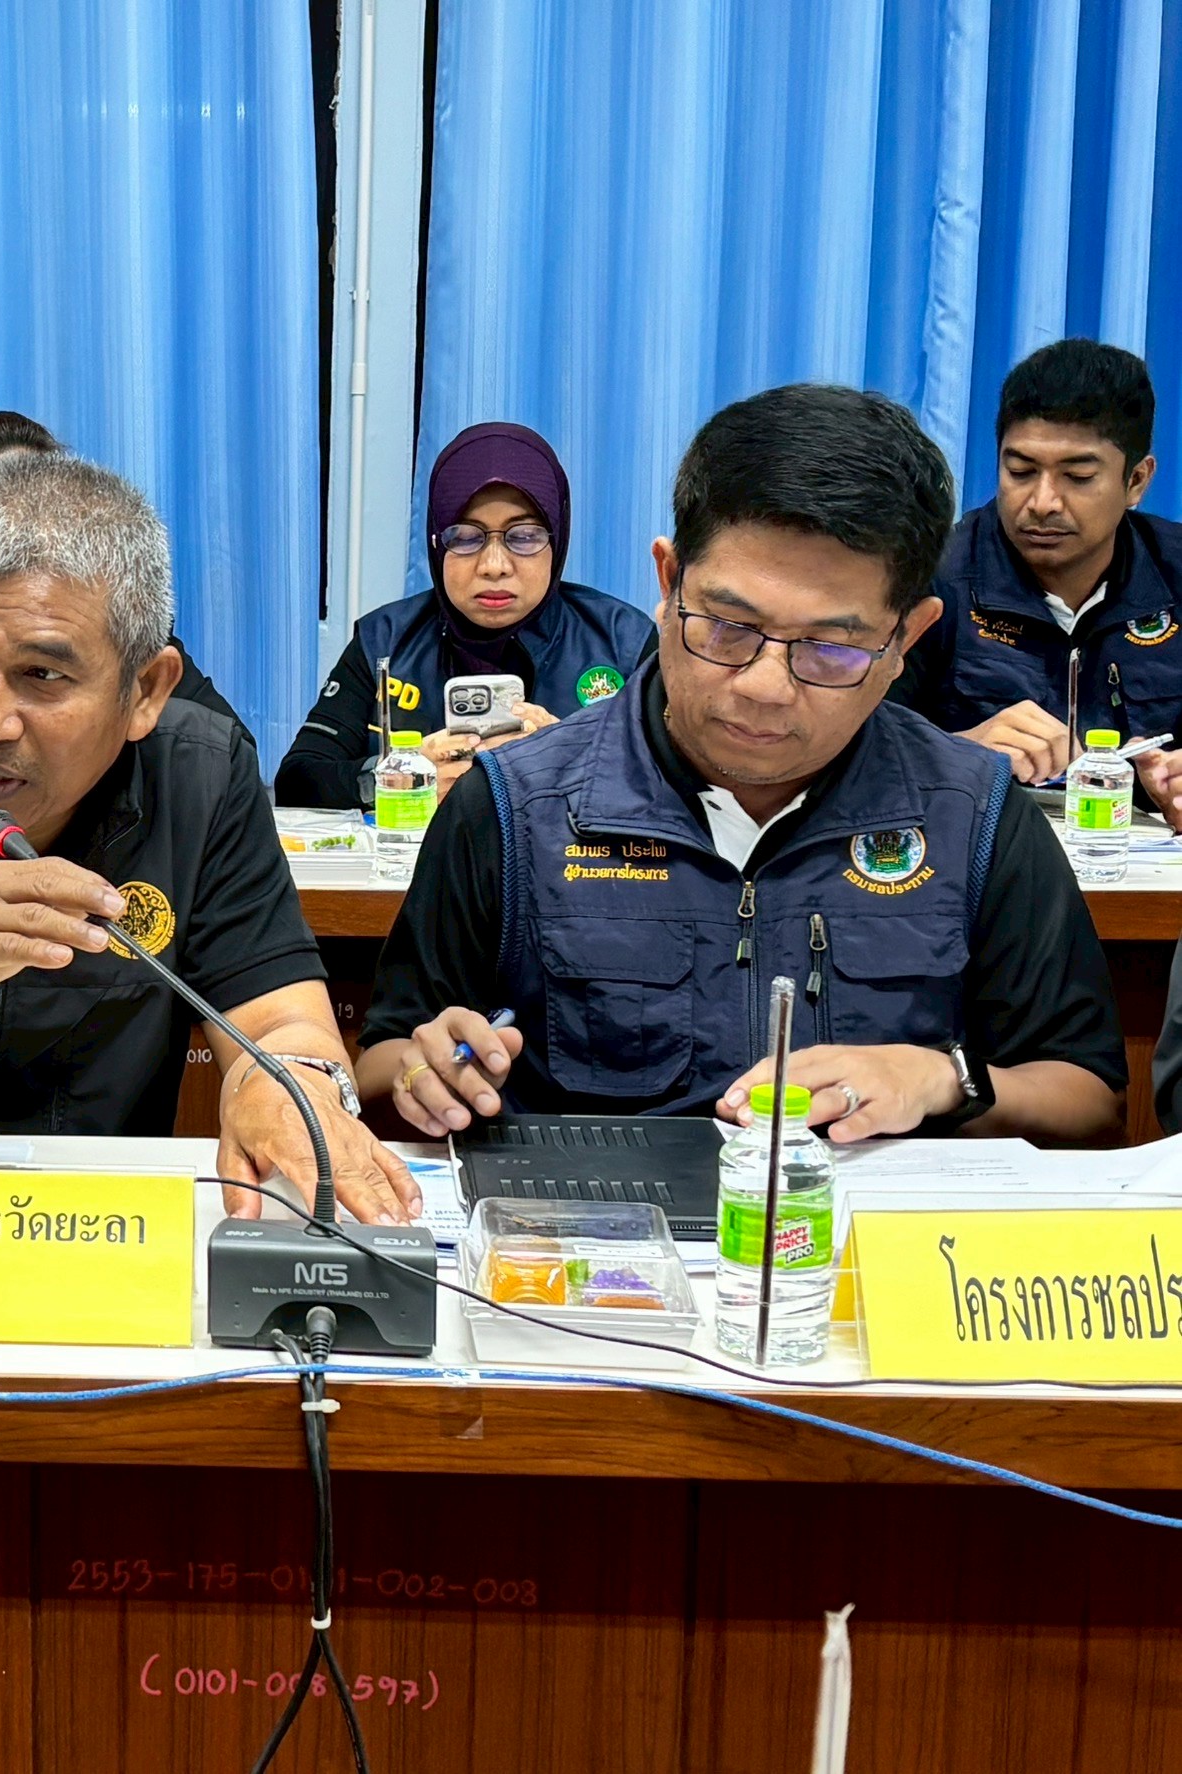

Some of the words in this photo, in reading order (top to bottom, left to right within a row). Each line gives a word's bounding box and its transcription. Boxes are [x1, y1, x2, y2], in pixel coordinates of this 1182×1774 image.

[564, 843, 611, 858] สมพร
[621, 839, 667, 858] ประไพ
[775, 1234, 808, 1252] PRICE
[786, 1245, 813, 1262] PRO
[938, 1233, 1182, 1342] โครงการชลปร
[67, 1558, 540, 1607] 2553-175-011-002-003
